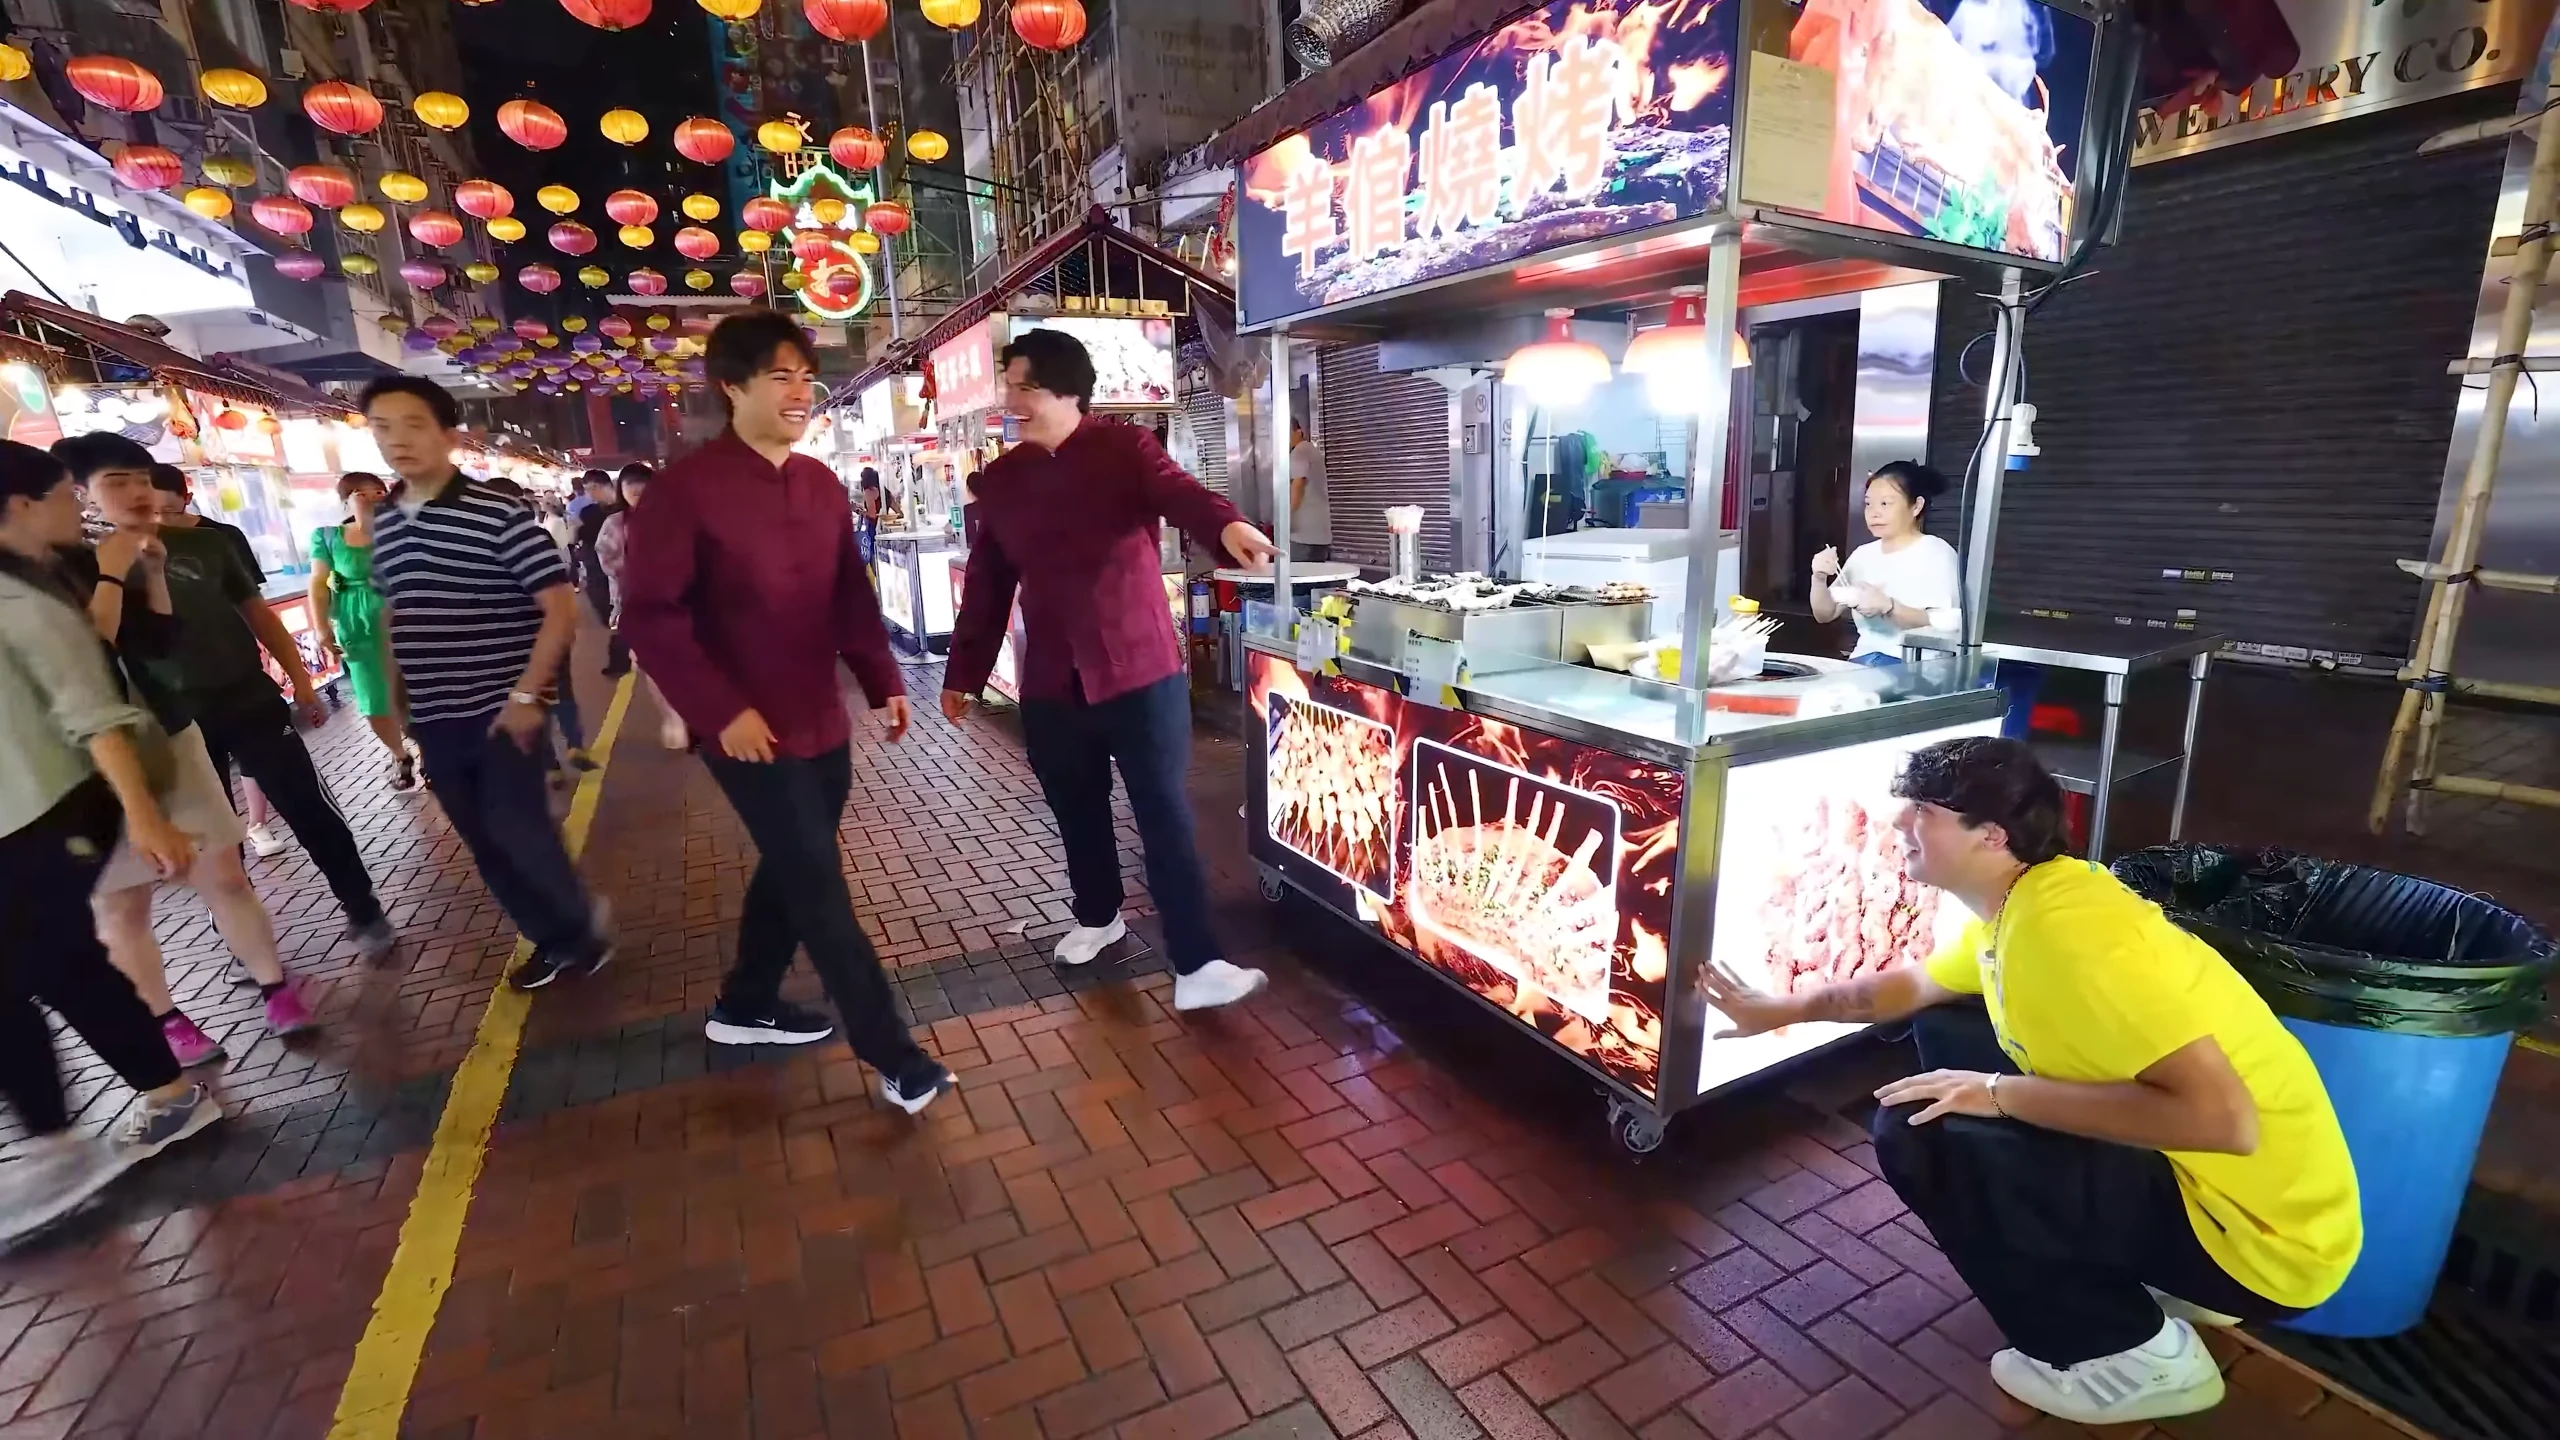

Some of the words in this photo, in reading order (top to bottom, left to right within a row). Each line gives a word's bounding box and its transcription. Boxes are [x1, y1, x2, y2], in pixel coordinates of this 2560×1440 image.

[2394, 26, 2501, 83] CO.
[1283, 35, 1618, 278] 羊倌燒烤
